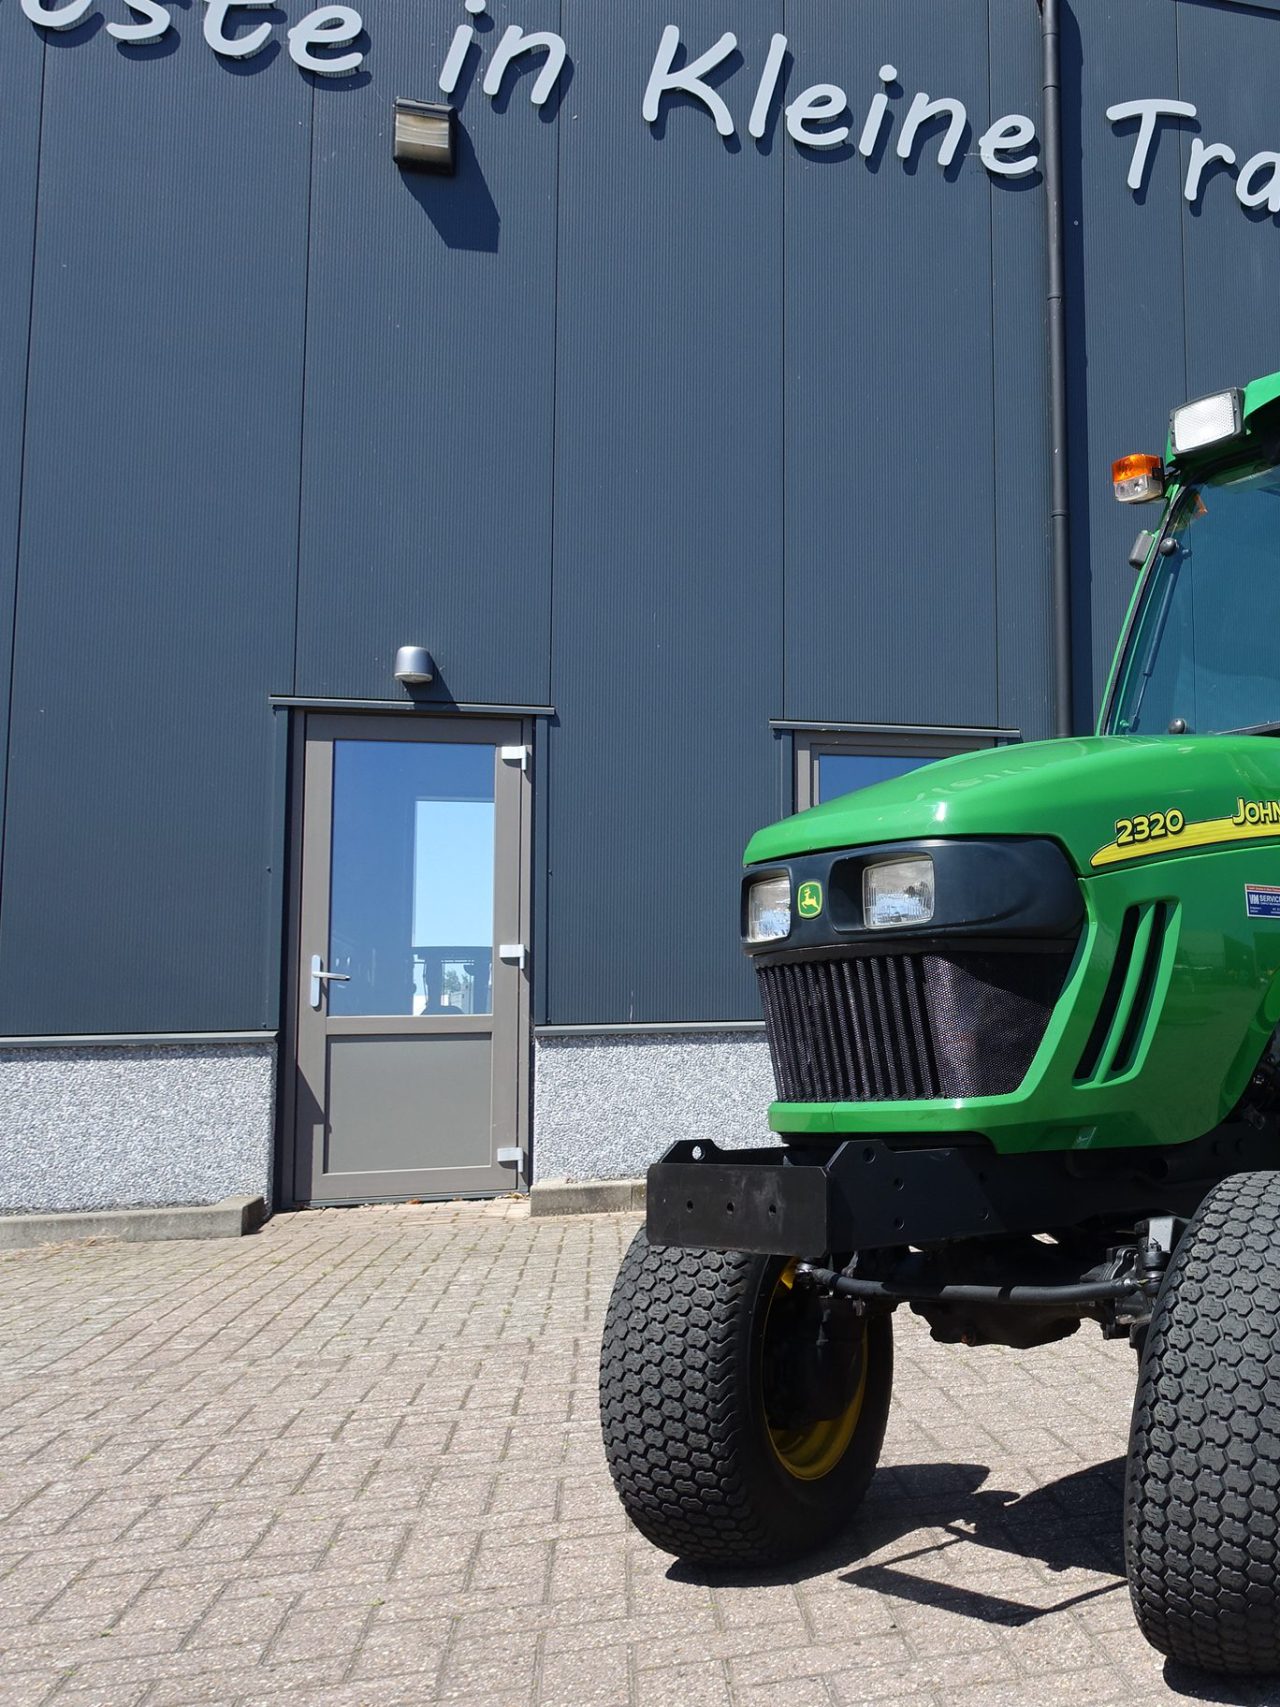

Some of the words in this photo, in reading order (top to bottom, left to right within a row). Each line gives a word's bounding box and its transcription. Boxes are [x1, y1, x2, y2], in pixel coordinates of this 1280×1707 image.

[438, 0, 567, 105] in
[642, 24, 1038, 175] Kleine
[1115, 808, 1185, 846] 2320
